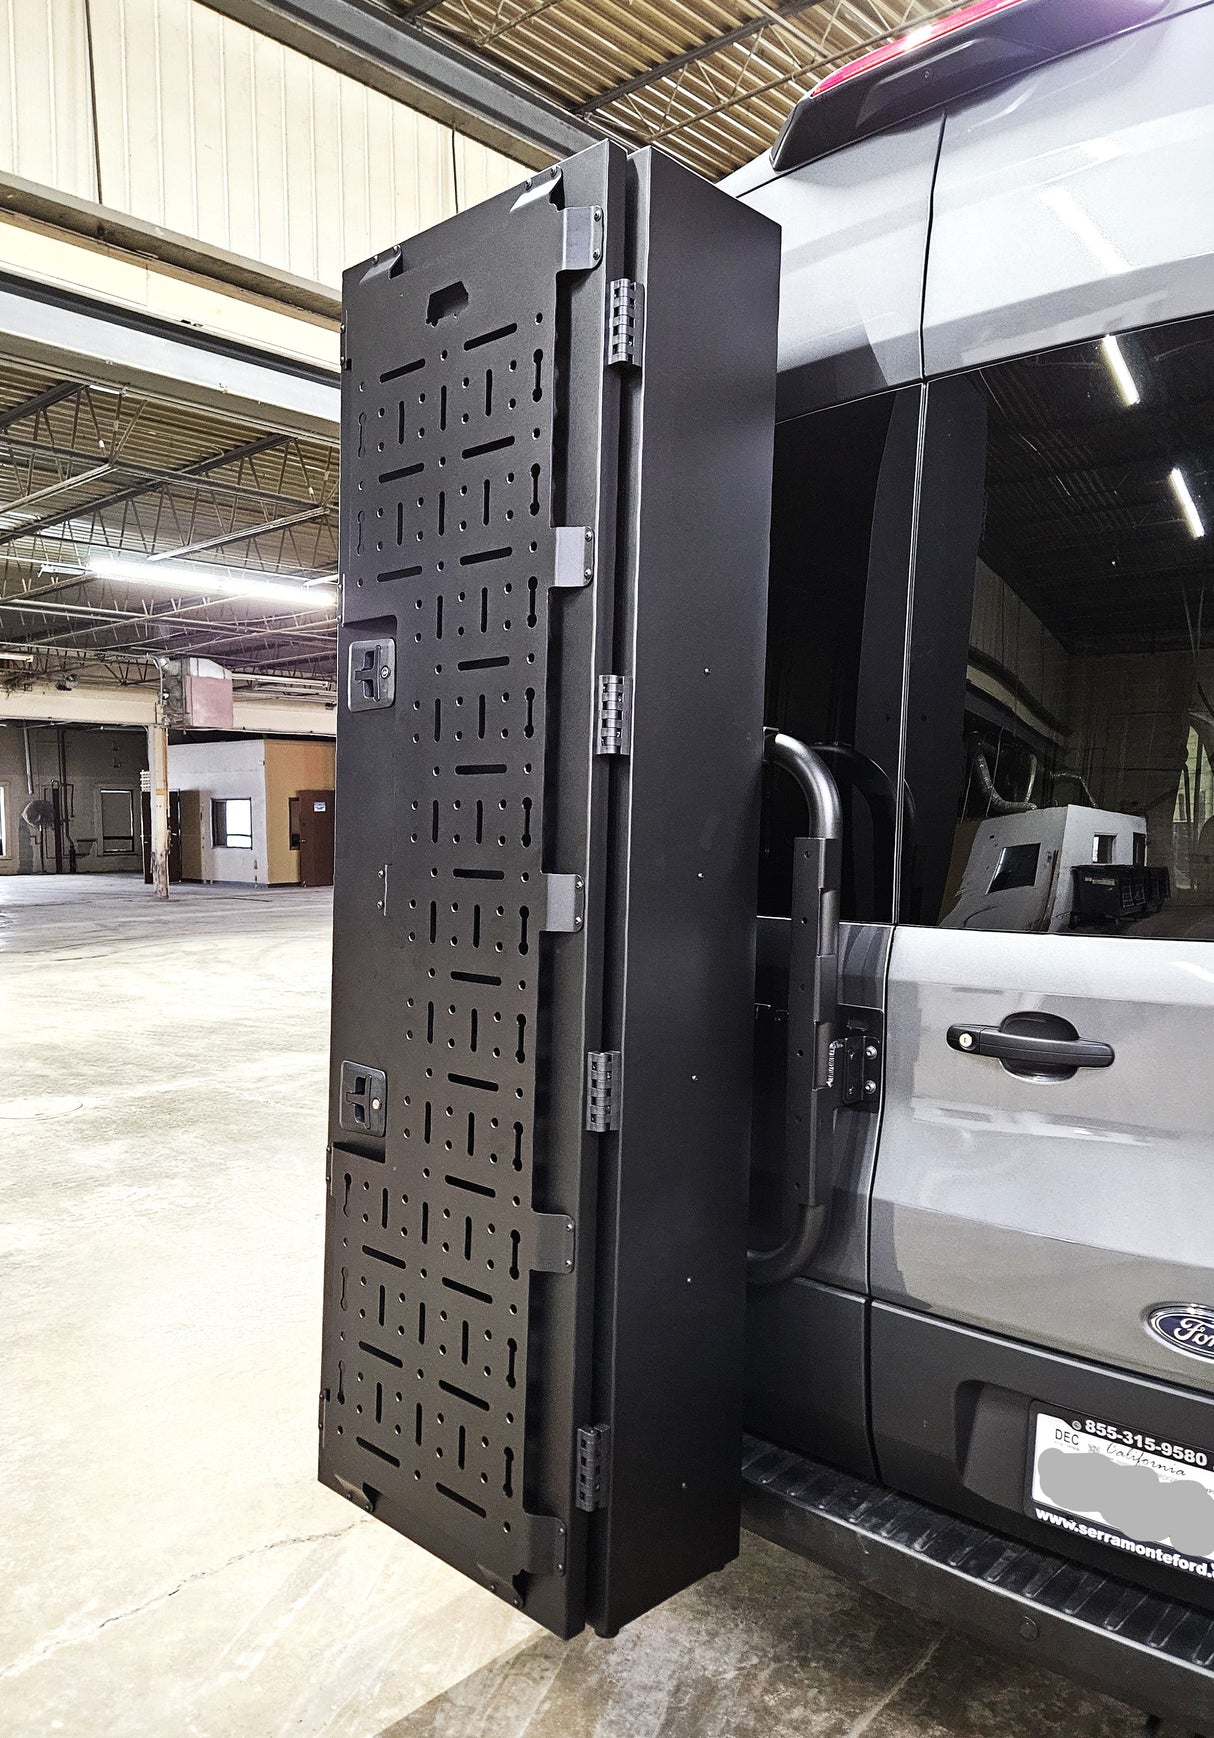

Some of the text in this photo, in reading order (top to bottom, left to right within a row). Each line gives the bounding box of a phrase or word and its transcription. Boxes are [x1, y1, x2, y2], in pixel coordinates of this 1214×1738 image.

[1055, 1429, 1079, 1446] DEC
[1085, 1420, 1207, 1466] 855-315-9580
[1106, 1442, 1187, 1476] California
[1035, 1508, 1214, 1579] www.serramonteford.
